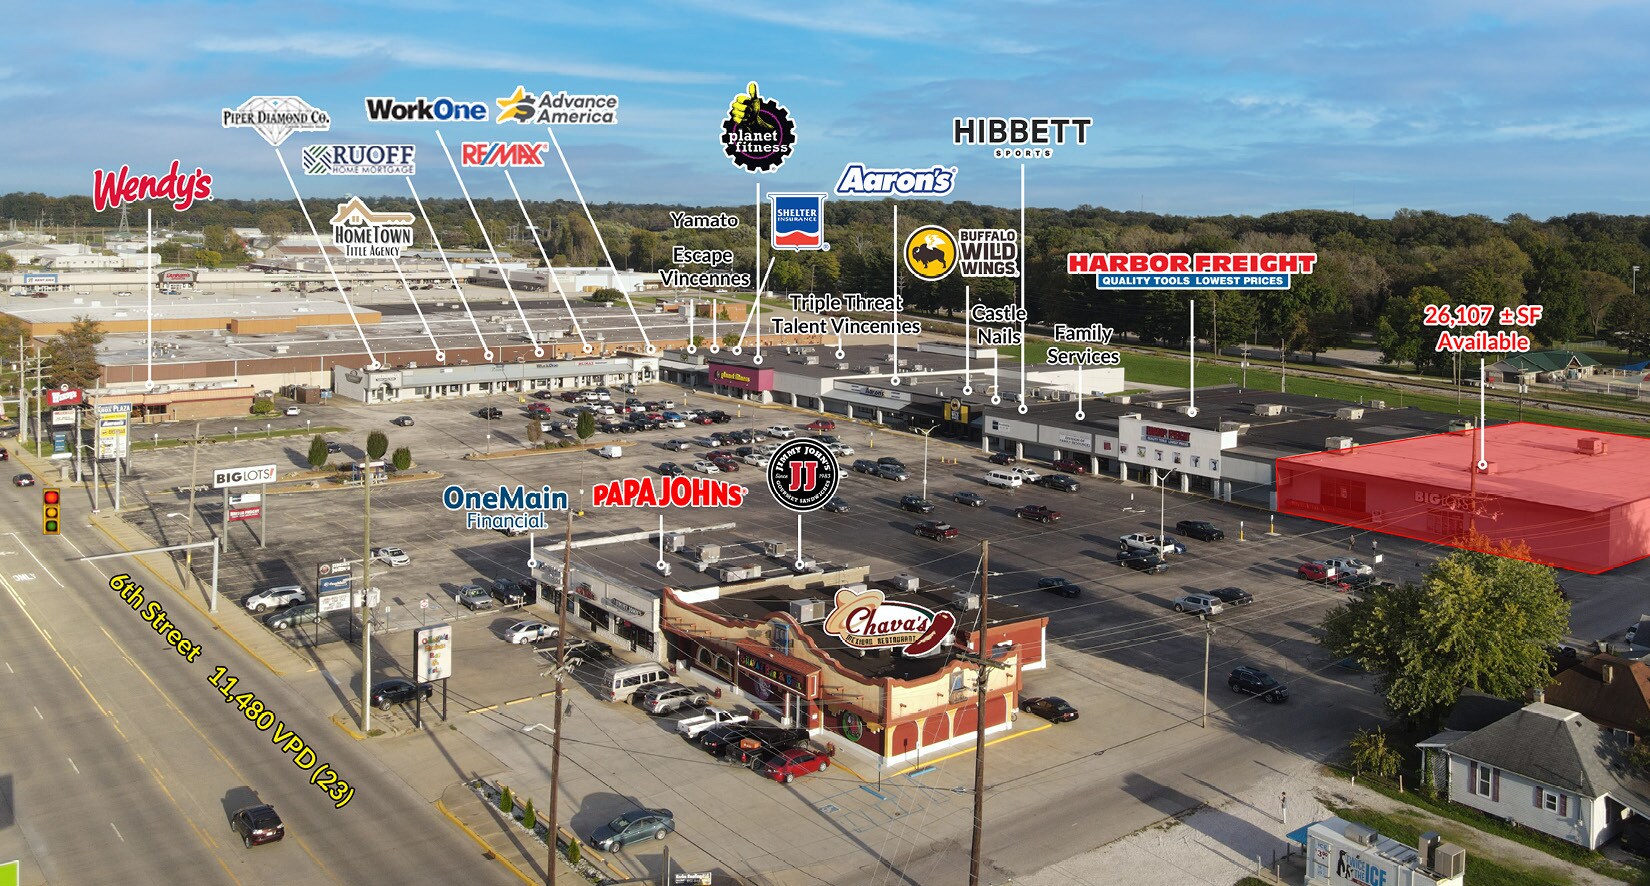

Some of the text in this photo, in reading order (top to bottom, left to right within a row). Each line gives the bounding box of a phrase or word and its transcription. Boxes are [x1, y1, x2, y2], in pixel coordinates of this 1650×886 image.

[216, 468, 275, 484] BIG LOTS!
[1415, 490, 1440, 504] BIG
